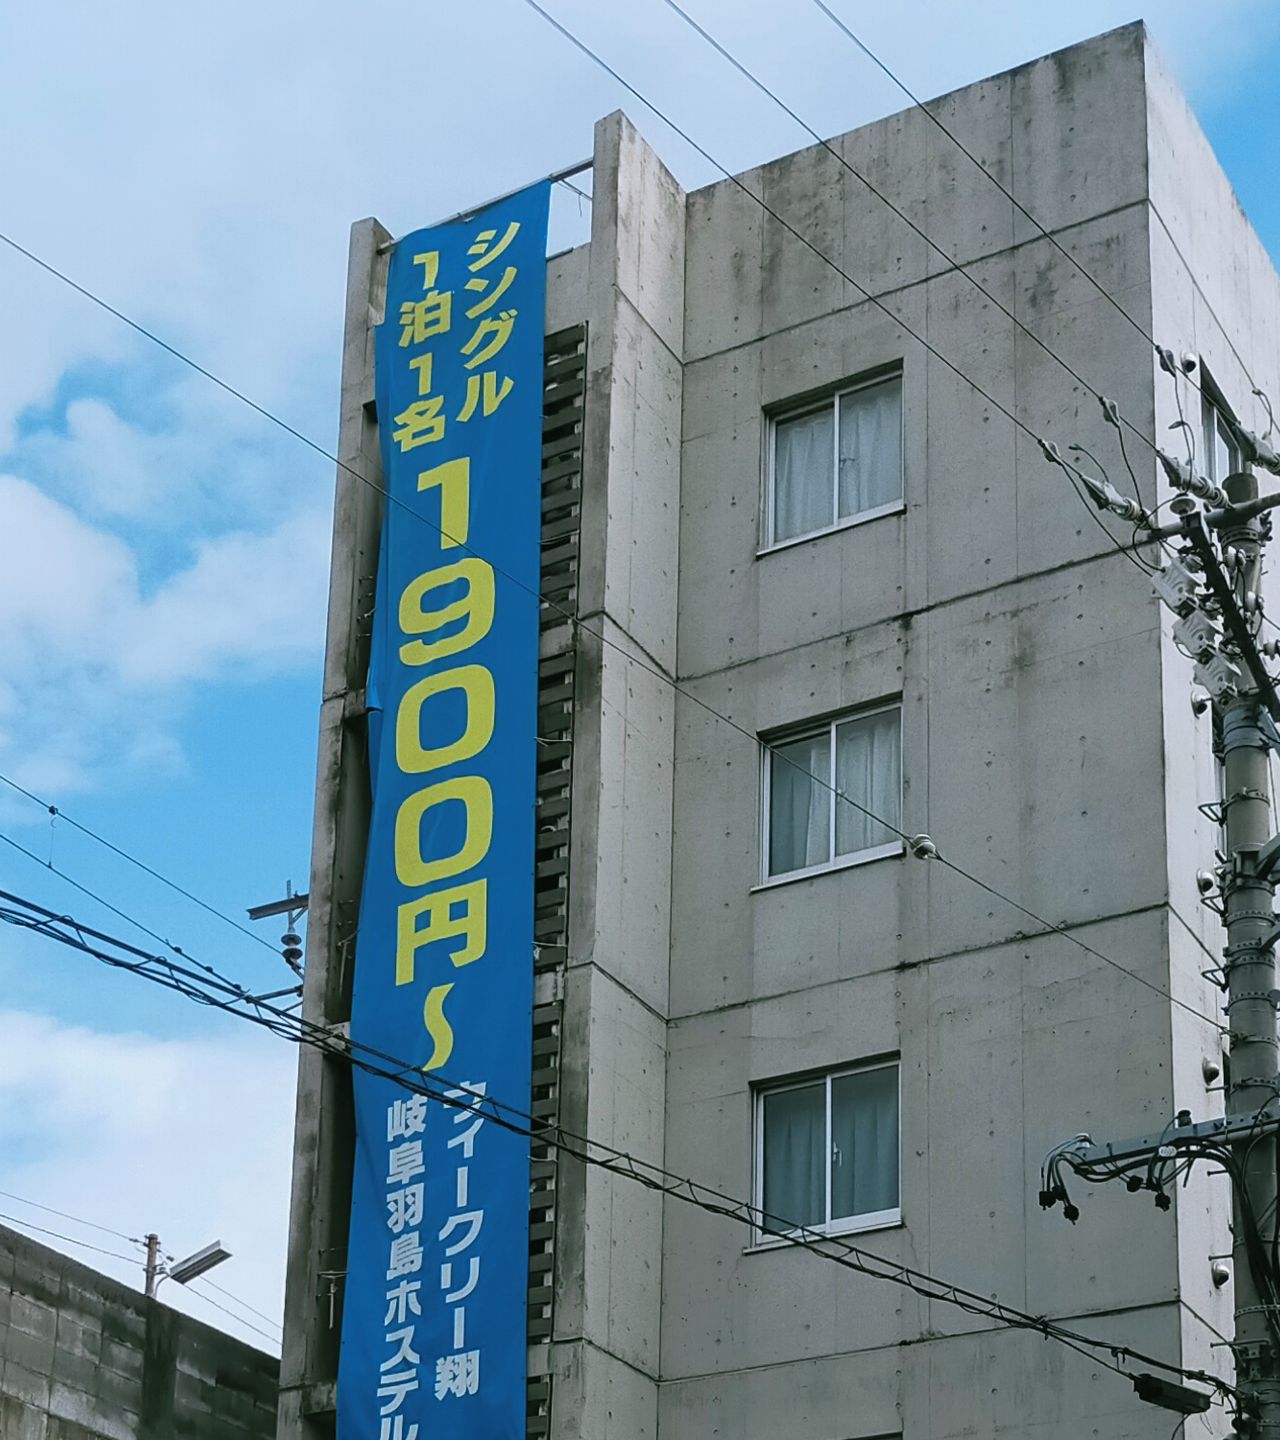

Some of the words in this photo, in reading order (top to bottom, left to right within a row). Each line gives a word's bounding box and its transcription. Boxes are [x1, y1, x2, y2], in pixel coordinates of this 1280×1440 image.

[392, 251, 454, 452] 1泊1名
[456, 221, 522, 423] シングル
